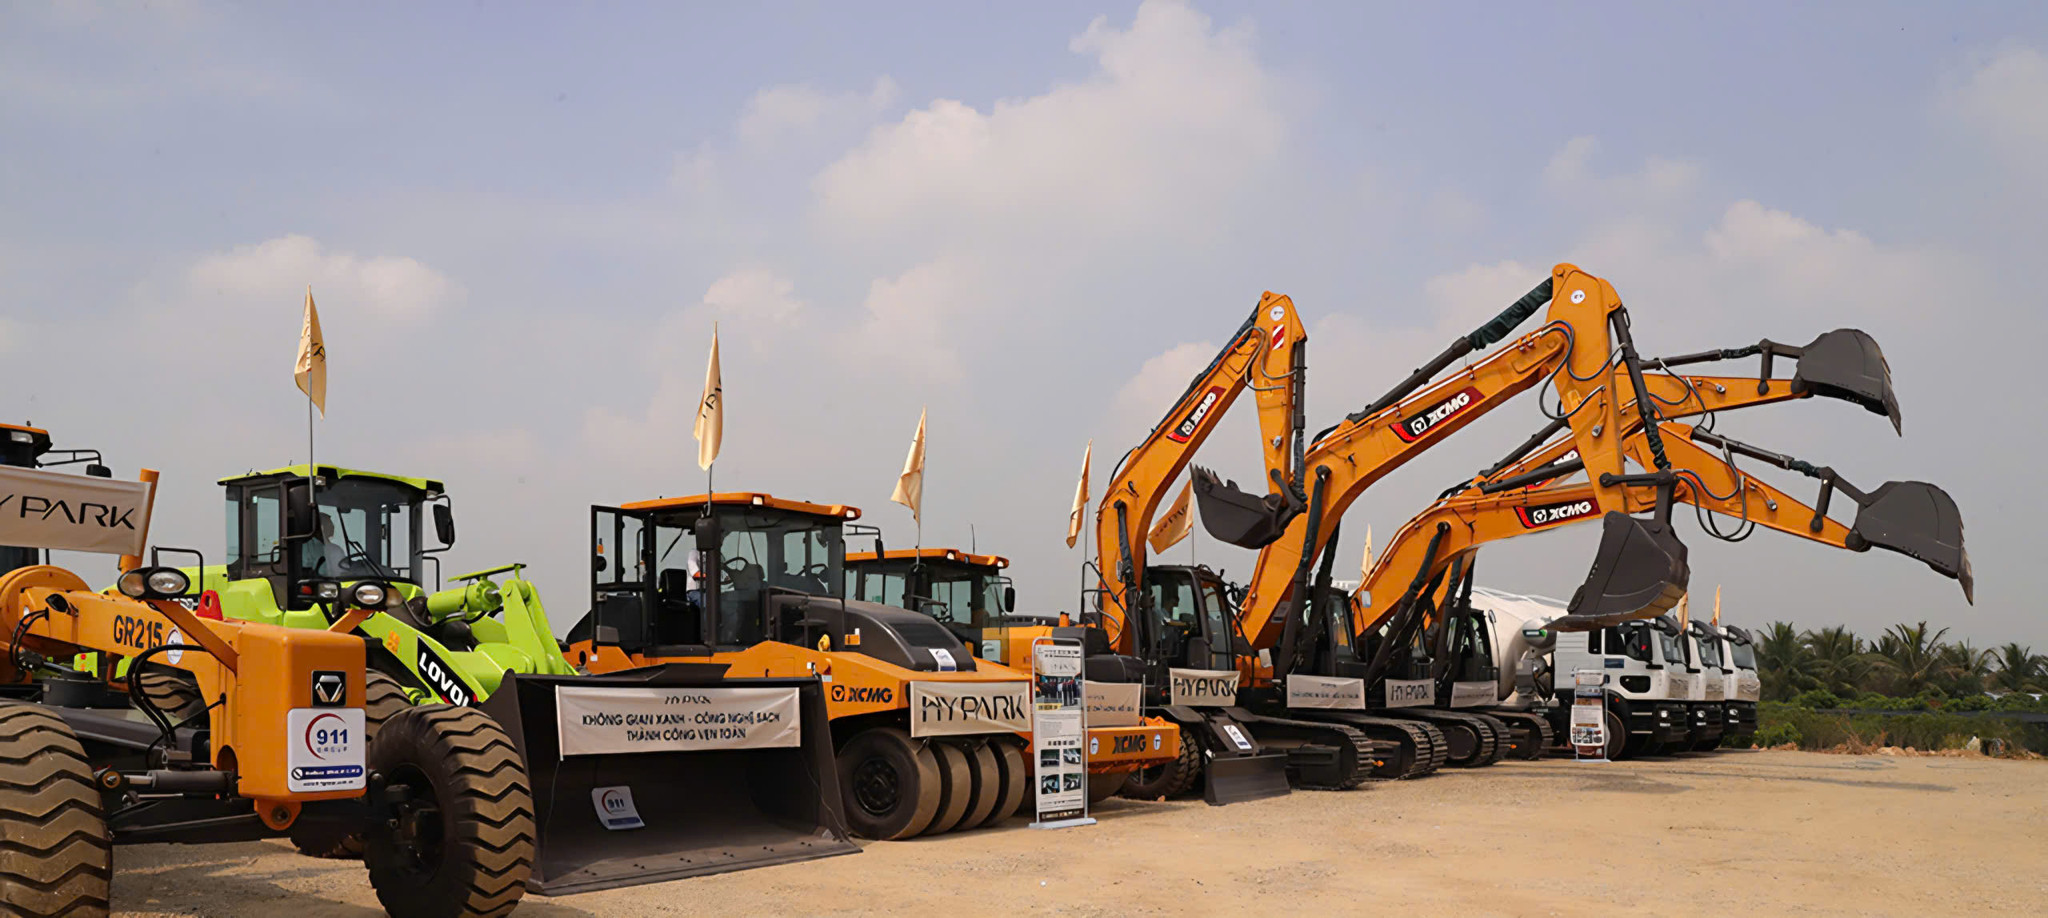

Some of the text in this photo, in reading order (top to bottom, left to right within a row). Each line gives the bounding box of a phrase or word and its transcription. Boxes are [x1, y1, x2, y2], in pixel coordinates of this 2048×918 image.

[1191, 392, 1216, 426] XCMG
[1426, 392, 1470, 427] XCMG
[1549, 501, 1591, 520] XCMG
[114, 615, 162, 649] GR215
[848, 687, 893, 703] XCMG
[583, 712, 623, 726] KHÔNG
[656, 714, 685, 725] XANH
[317, 729, 348, 745] 911
[663, 728, 696, 741] CÔNG
[1112, 734, 1147, 754] XCMG
